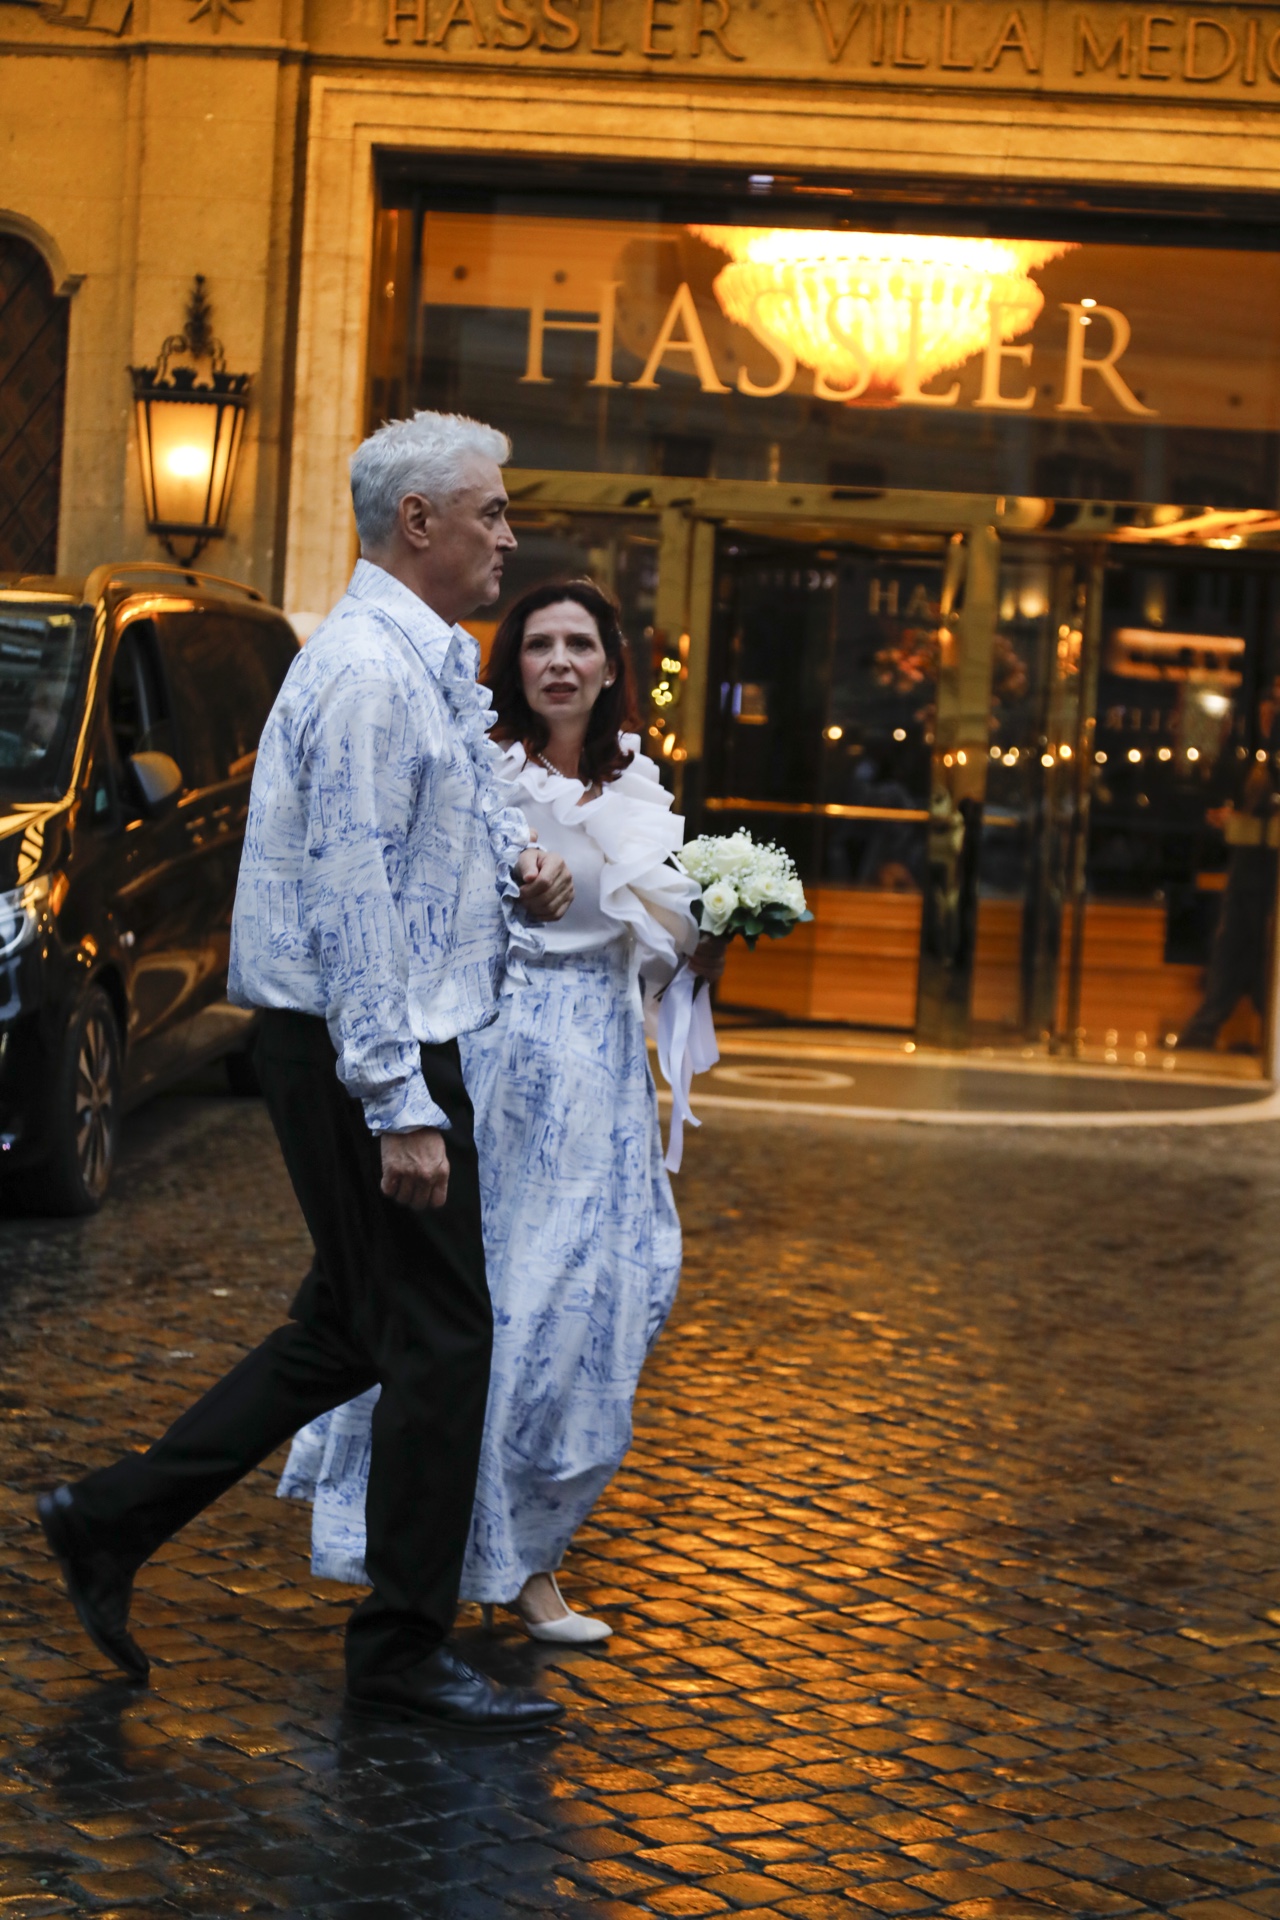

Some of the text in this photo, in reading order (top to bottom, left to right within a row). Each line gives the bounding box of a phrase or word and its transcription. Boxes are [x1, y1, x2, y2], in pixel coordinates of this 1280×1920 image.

[384, 0, 746, 62] HASSLER
[811, 0, 1040, 75] VILLA
[518, 281, 1159, 417] HASSLER
